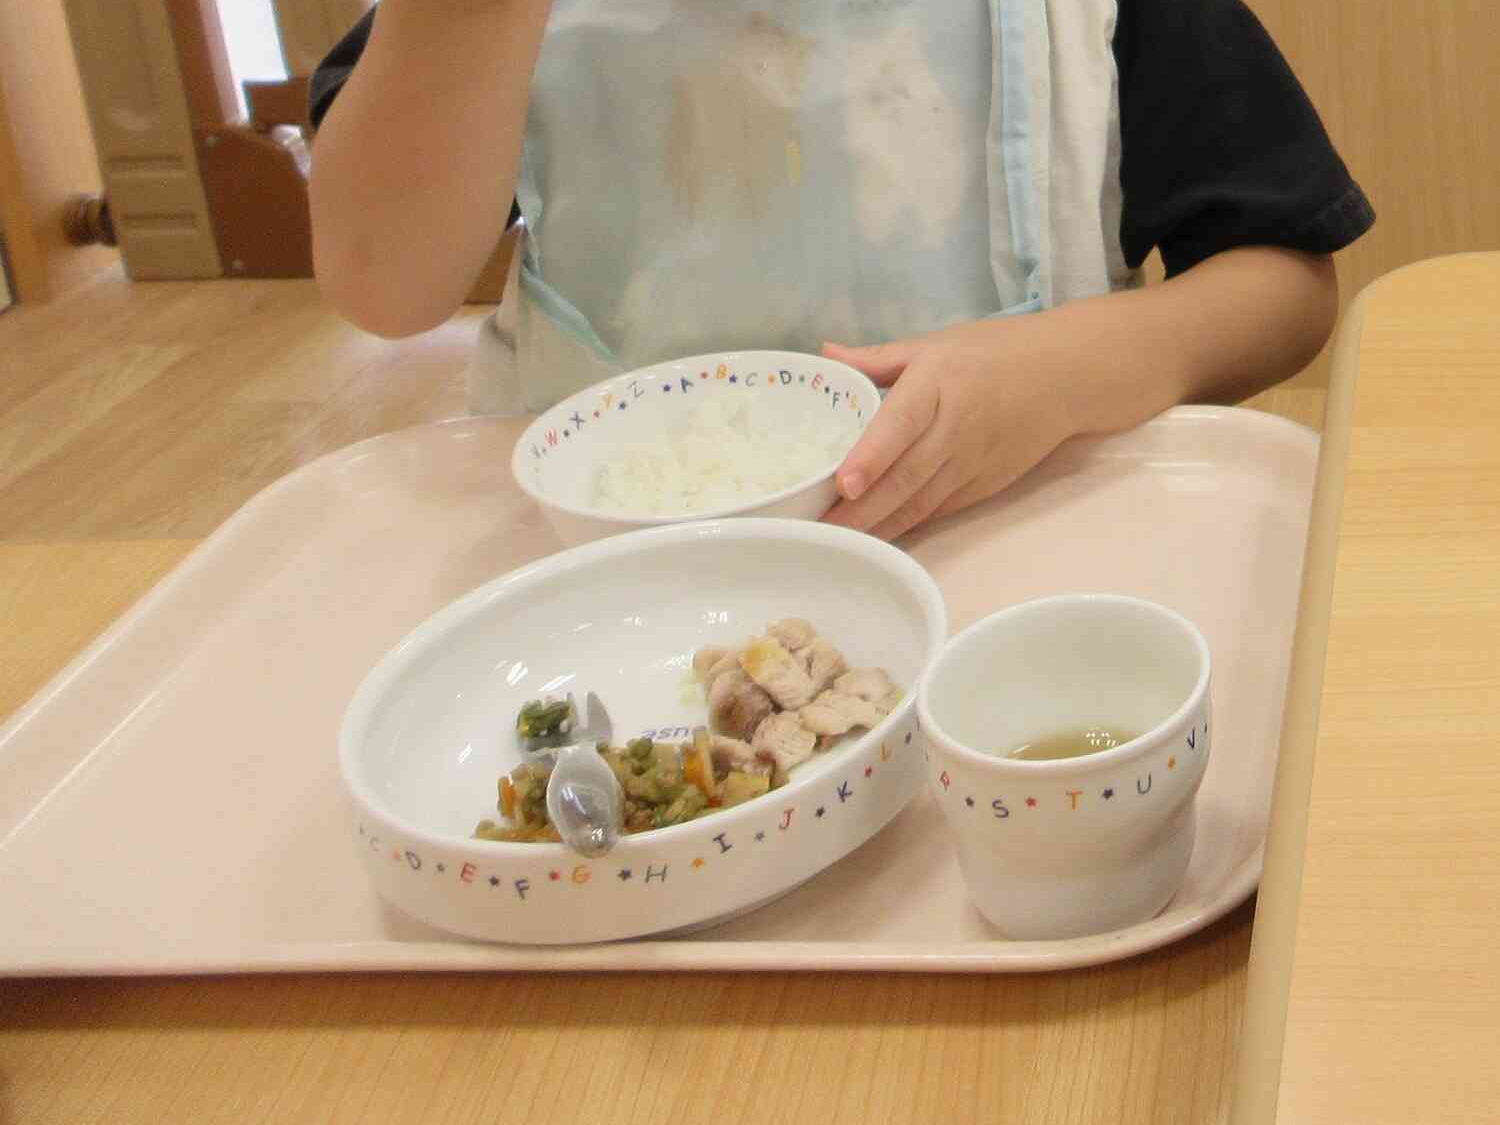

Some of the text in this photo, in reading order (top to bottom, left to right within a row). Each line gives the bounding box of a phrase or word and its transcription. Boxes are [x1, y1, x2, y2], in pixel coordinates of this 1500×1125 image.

[569, 411, 586, 430] X
[680, 376, 694, 393] A
[716, 363, 727, 380] B
[746, 372, 758, 387] C
[779, 370, 792, 385] D
[811, 373, 823, 390] E
[832, 392, 840, 409] F
[992, 799, 1009, 818] S
[1065, 790, 1083, 810] T
[1137, 773, 1152, 795] U
[406, 850, 421, 870] D
[460, 862, 477, 883] E
[515, 879, 529, 900] F
[571, 865, 592, 884] G
[644, 865, 667, 884] H
[713, 832, 733, 854] I
[779, 808, 795, 830] J
[837, 780, 853, 803] K
